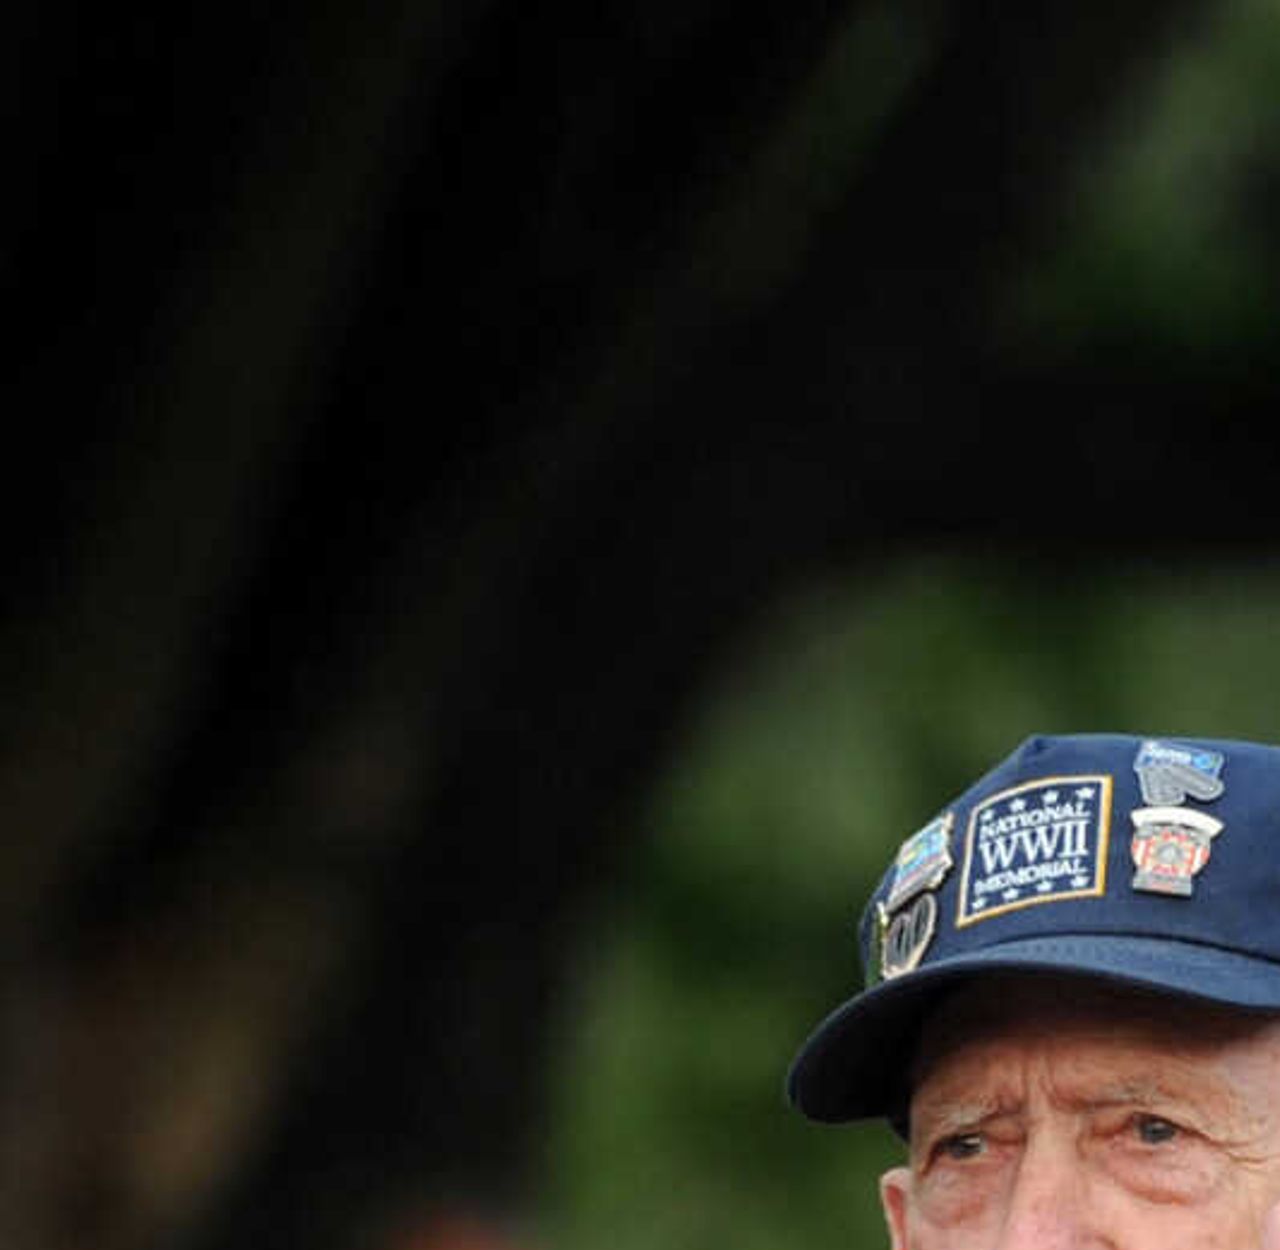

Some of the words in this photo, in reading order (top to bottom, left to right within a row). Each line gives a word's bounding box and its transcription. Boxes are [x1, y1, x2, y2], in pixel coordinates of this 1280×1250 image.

[979, 801, 1091, 842] NATIONAL
[979, 820, 1090, 874] WWII
[974, 858, 1088, 895] MEMORIAL
